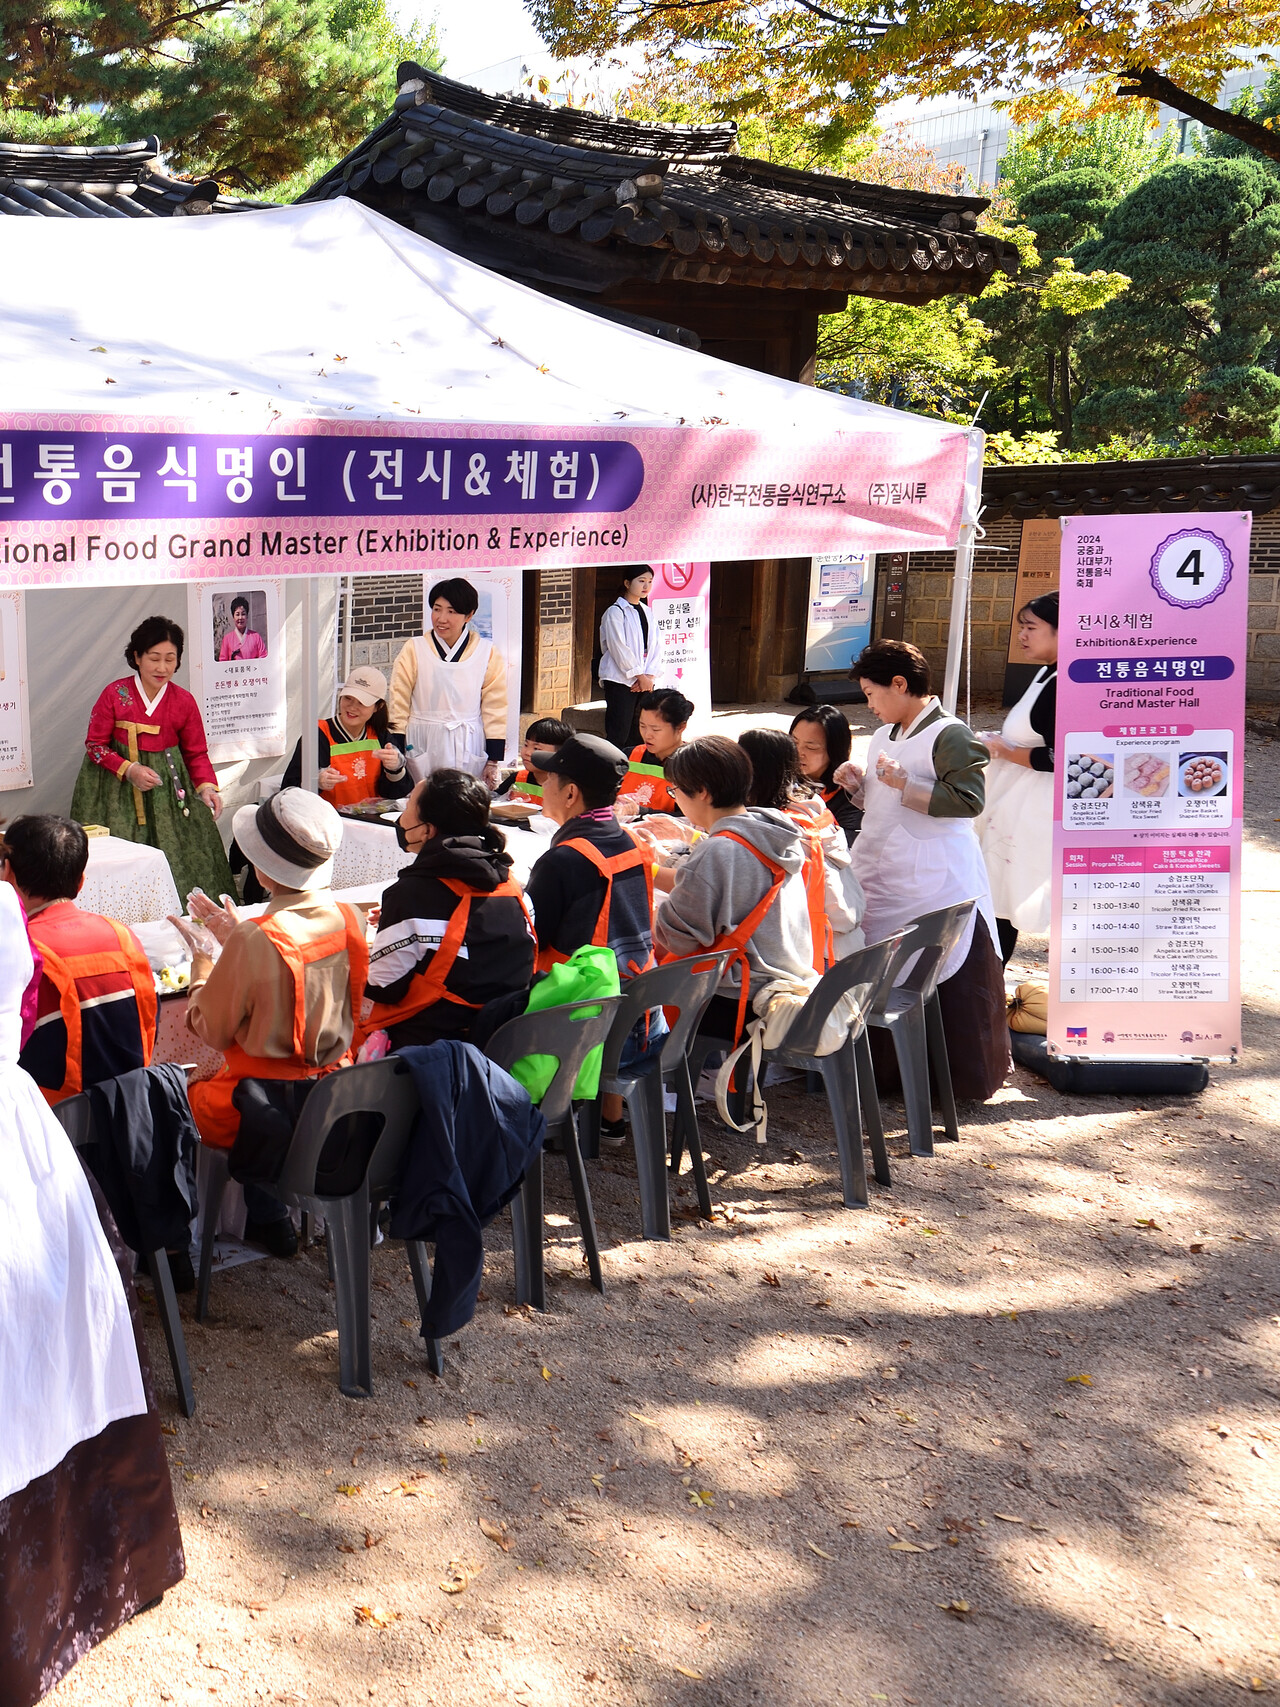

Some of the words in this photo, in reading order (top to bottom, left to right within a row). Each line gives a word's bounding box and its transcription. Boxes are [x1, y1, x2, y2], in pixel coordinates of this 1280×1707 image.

[342, 449, 600, 503] (전시&체험)
[692, 483, 847, 511] (사)한국전통음식연구소
[868, 482, 928, 505] (주)질시루
[87, 535, 157, 562] Food
[168, 532, 251, 559] Grand
[261, 531, 348, 557] Master
[356, 527, 478, 557] (Exhibition
[487, 527, 501, 550] &
[510, 524, 629, 555] Experience)
[1077, 535, 1101, 544] 2024
[1077, 546, 1104, 555] 궁중과
[1077, 557, 1112, 566] 사대부가
[1176, 549, 1205, 585] 4
[1077, 568, 1111, 577] 전통음식
[1076, 579, 1093, 588] 축제
[668, 602, 691, 615] 음식물
[1078, 613, 1153, 630] 전시&체험
[1076, 637, 1197, 647] Exhibition&Experience
[1096, 660, 1205, 678] 전통음식명인
[1106, 688, 1163, 698] Traditional
[1166, 687, 1194, 697] Food
[1100, 700, 1134, 709] Grand
[1137, 699, 1175, 708] Master
[1179, 698, 1200, 707] Hall
[1119, 726, 1178, 735] 체험프로그램
[1072, 802, 1109, 810] 승검초단자
[1131, 800, 1161, 809] 삼색유과
